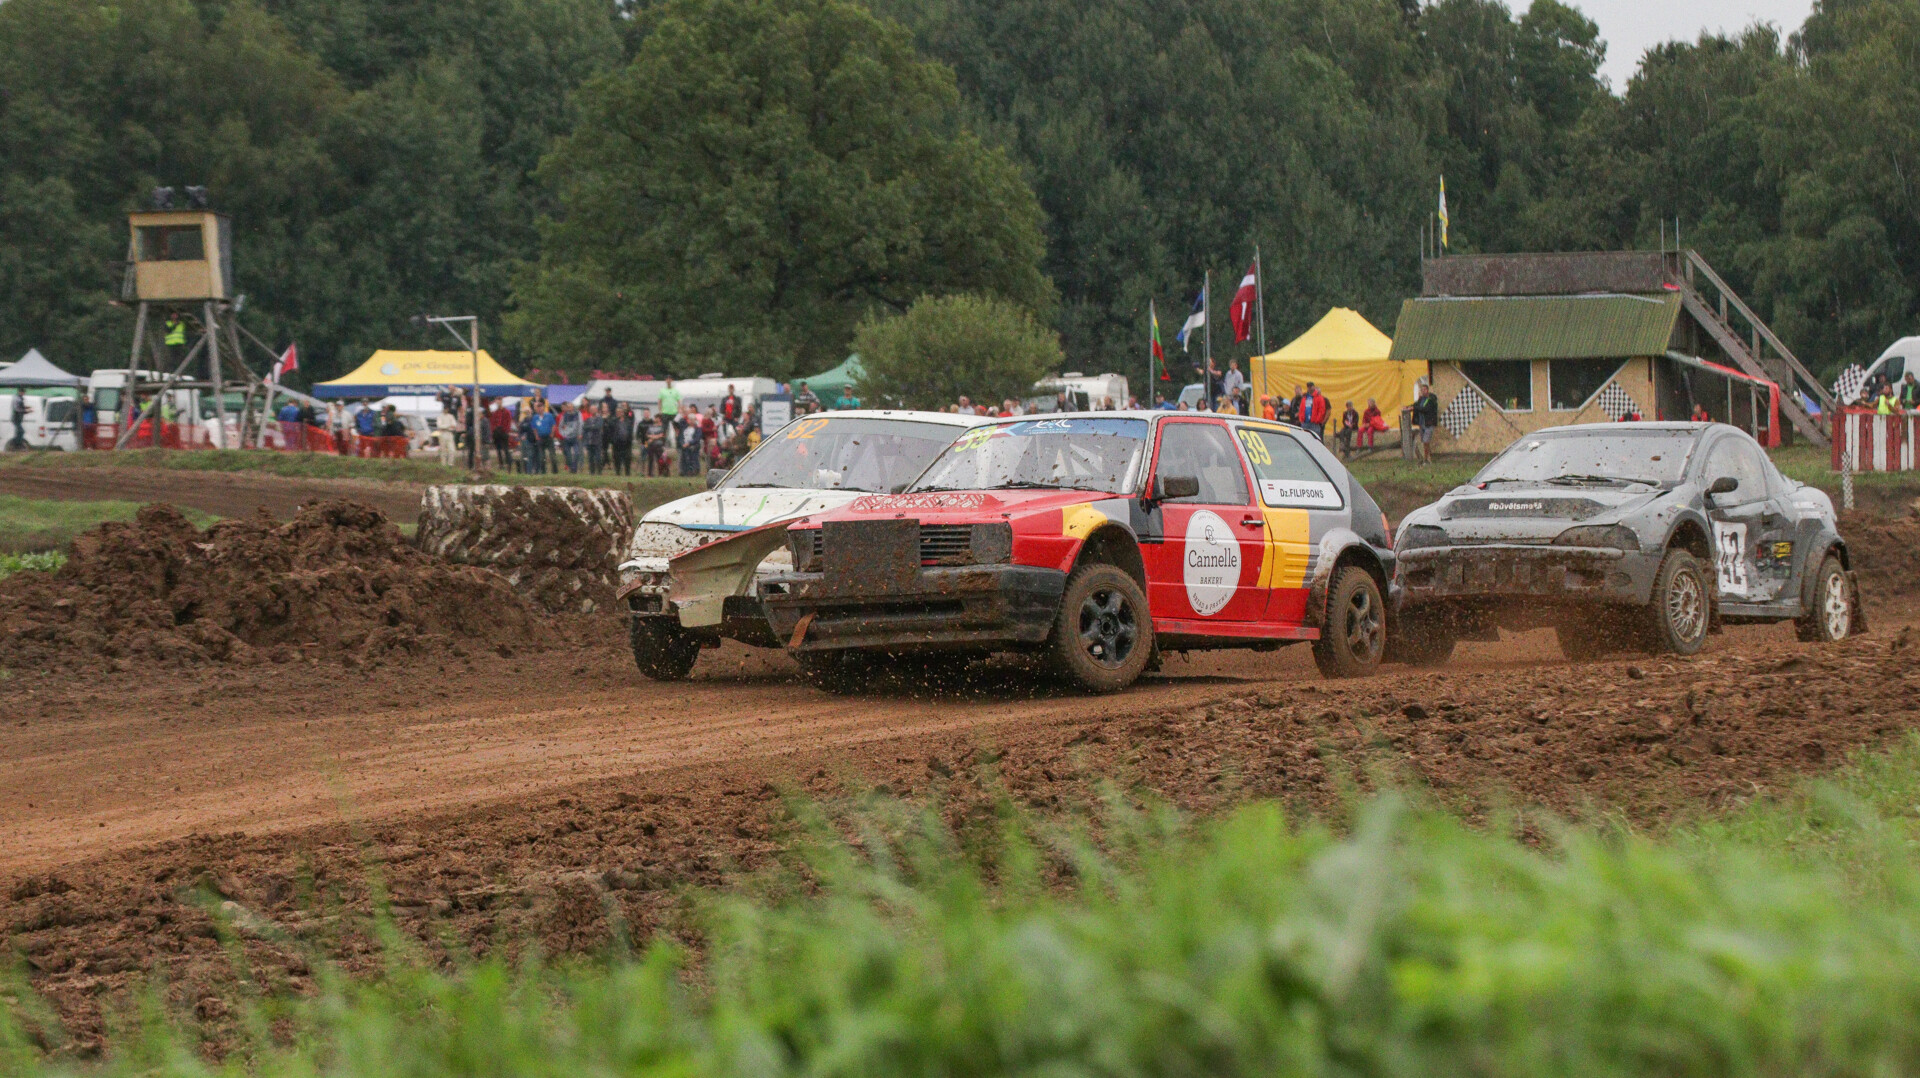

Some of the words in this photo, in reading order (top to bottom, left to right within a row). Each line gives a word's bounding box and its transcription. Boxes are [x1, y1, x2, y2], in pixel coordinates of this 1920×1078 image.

[787, 418, 829, 439] 82
[955, 426, 998, 452] 39
[1238, 429, 1272, 465] 39
[1280, 488, 1324, 498] Dz.FILIPSONS
[1188, 547, 1238, 568] Cannelle
[1200, 576, 1223, 584] BAKERY
